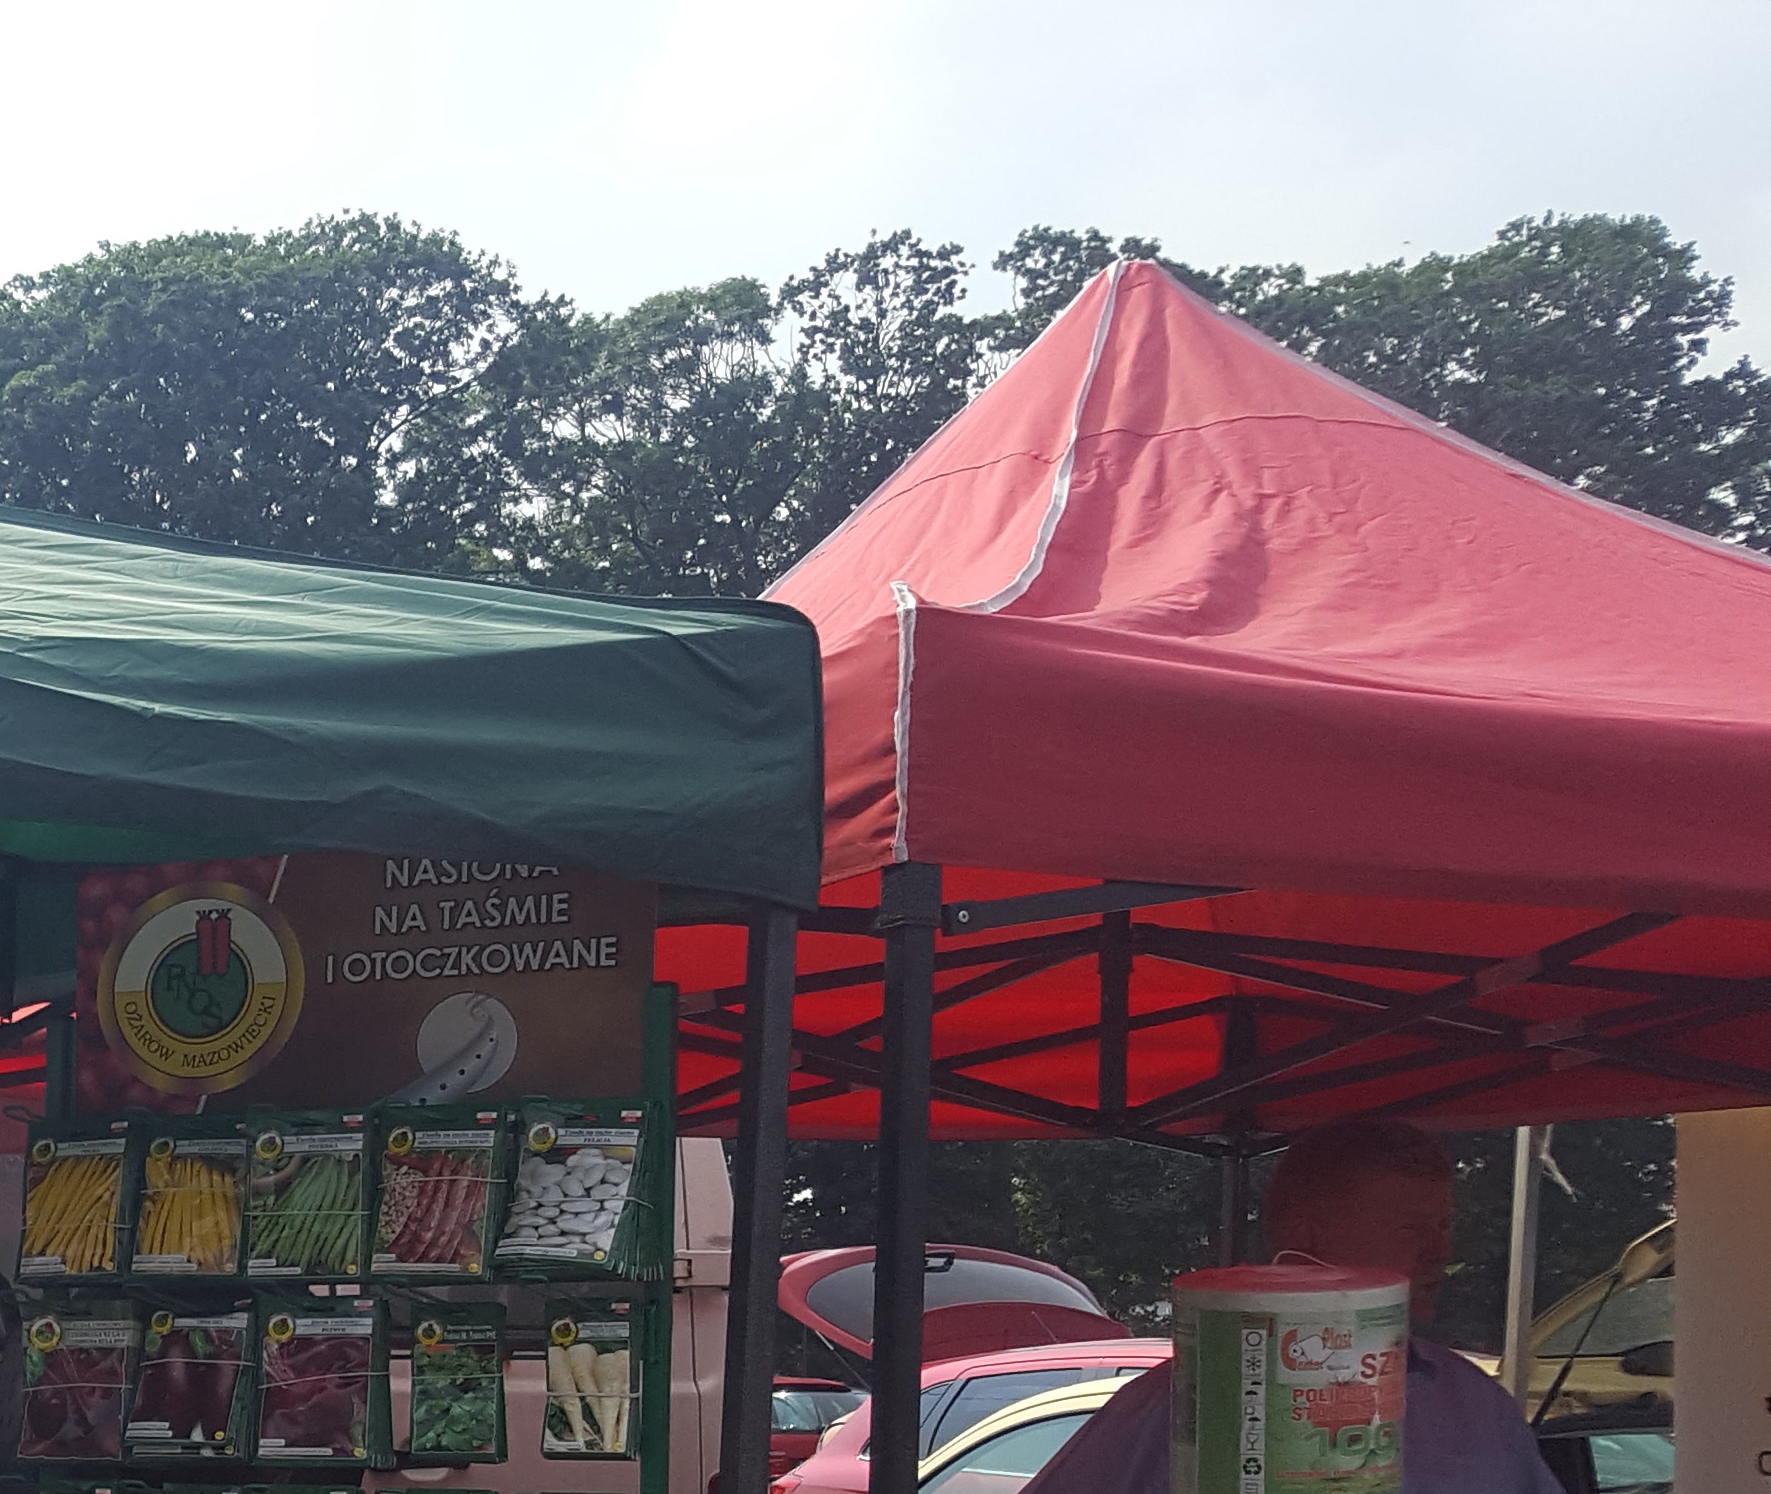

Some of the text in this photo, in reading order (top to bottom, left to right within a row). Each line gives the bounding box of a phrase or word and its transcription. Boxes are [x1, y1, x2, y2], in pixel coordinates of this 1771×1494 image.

[373, 887, 570, 935] NA TAŚMIE
[325, 936, 619, 983] I OTOCZKOWANE
[180, 994, 277, 1069] MAZOWIECKI
